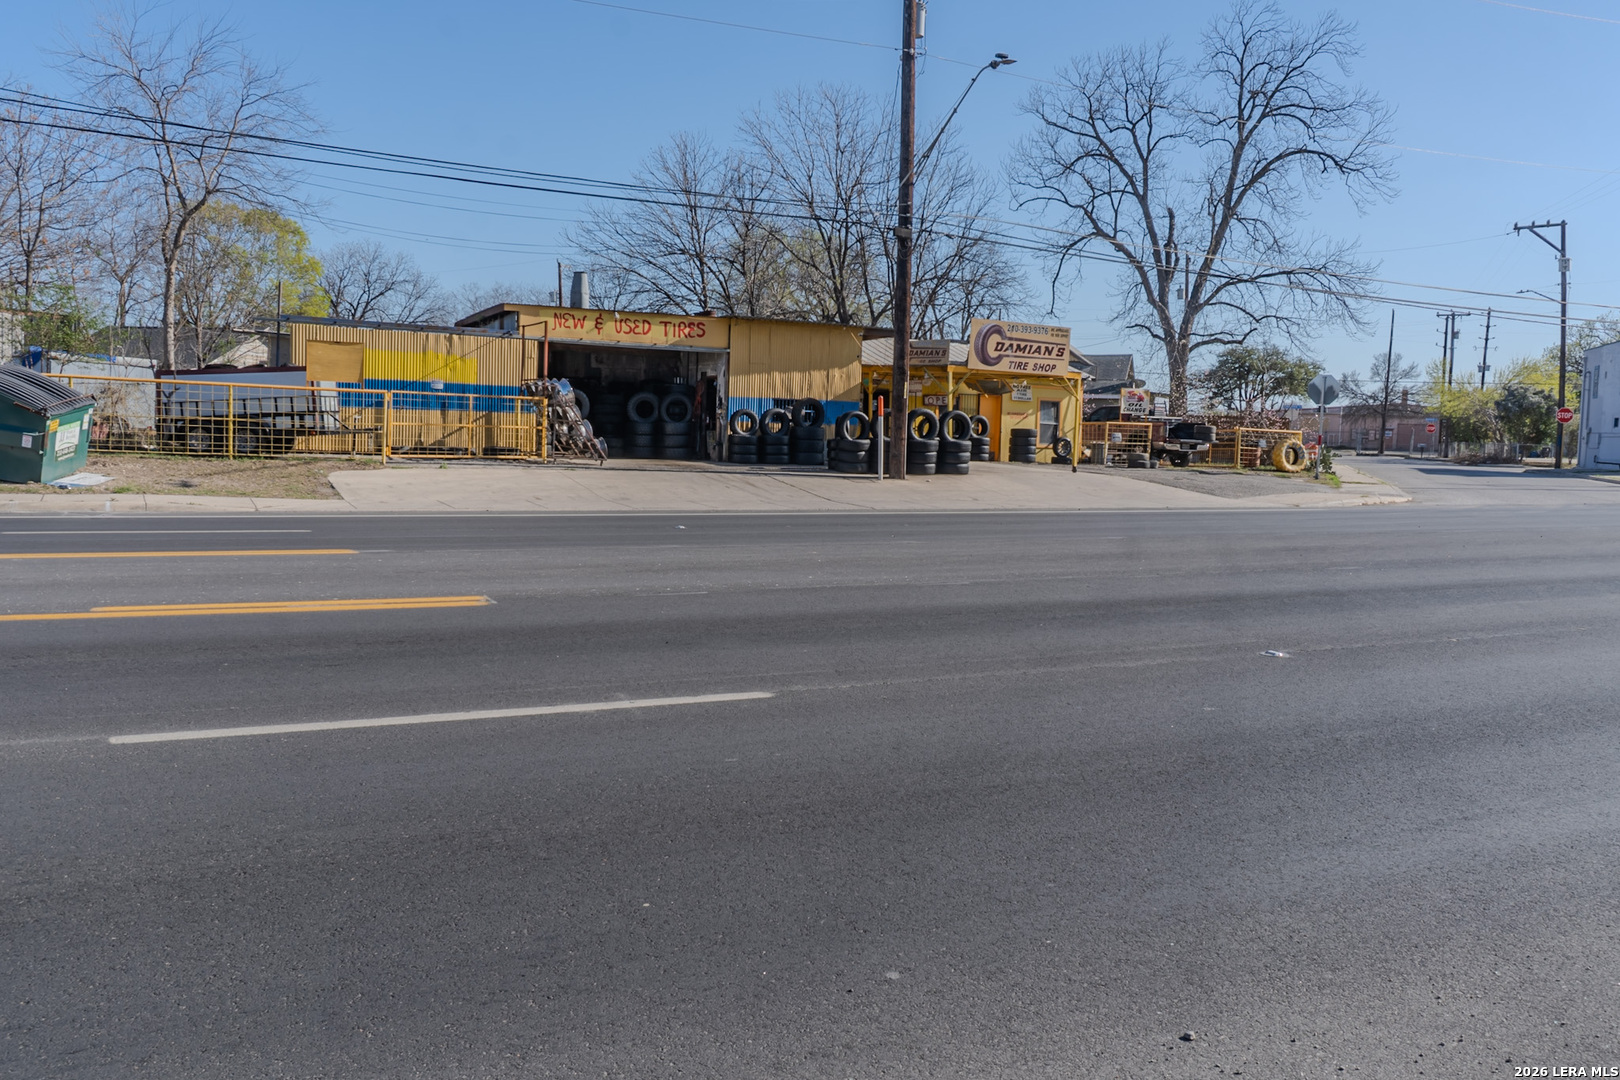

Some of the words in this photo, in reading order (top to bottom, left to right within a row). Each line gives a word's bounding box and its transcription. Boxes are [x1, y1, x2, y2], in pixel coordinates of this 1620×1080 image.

[552, 312, 587, 331] NEW
[594, 313, 604, 335] &
[614, 318, 652, 336] USED
[659, 321, 706, 339] TIRES
[993, 341, 1066, 358] DAMIAN'S
[1008, 361, 1030, 371] TIRE
[1032, 362, 1057, 373] SHOP
[927, 396, 947, 405] OPE
